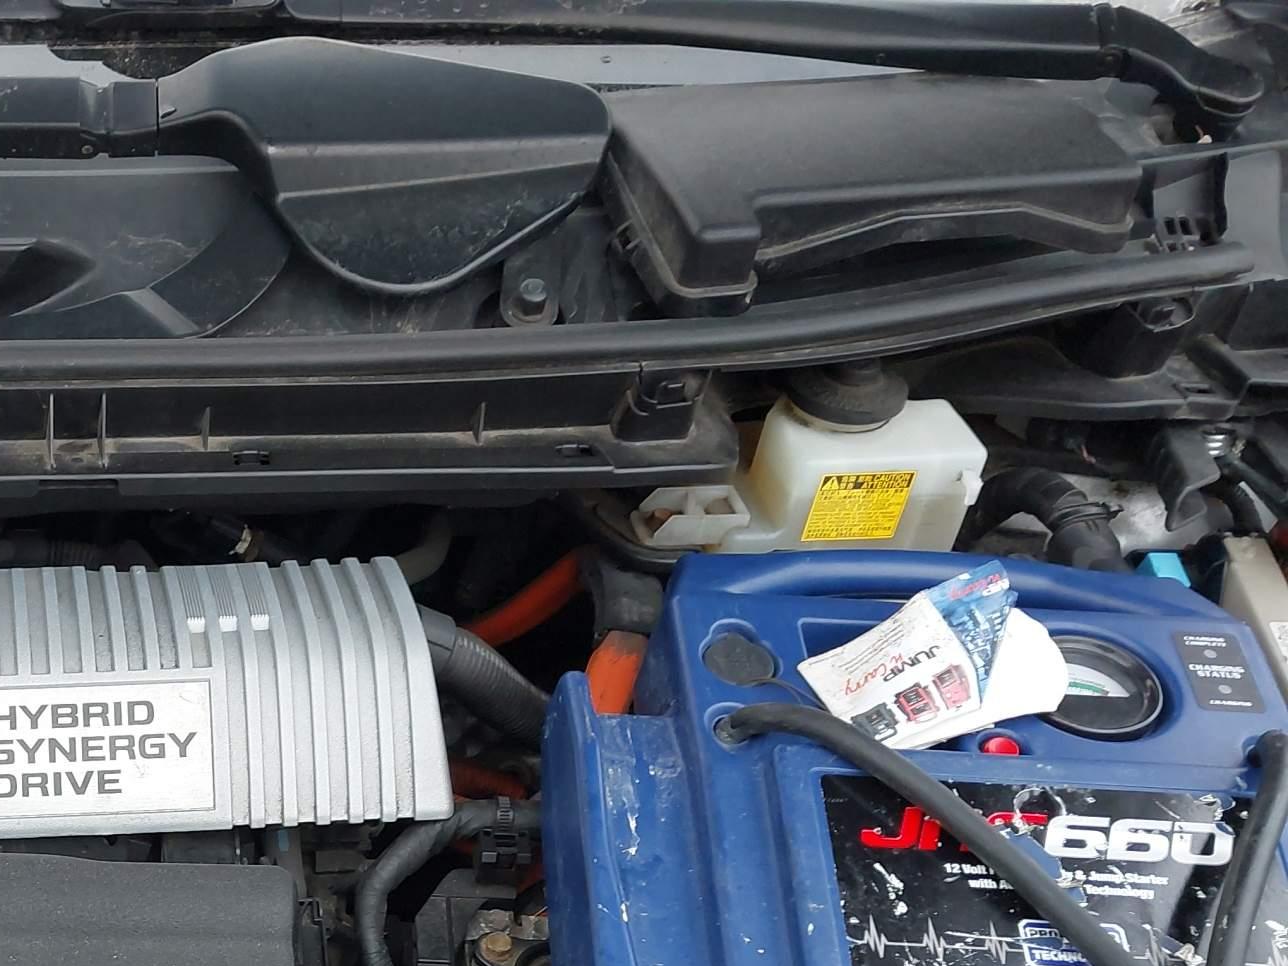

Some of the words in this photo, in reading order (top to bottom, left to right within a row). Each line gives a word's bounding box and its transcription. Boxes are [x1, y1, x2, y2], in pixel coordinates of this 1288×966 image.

[873, 473, 911, 481] CAUTION
[861, 480, 909, 489] ATTENTION
[883, 645, 941, 683] JUMP
[1188, 663, 1245, 673] CHARGING
[1197, 670, 1241, 680] STATUS
[944, 862, 961, 874] 12
[962, 863, 989, 876] Volt
[967, 878, 997, 890] with
